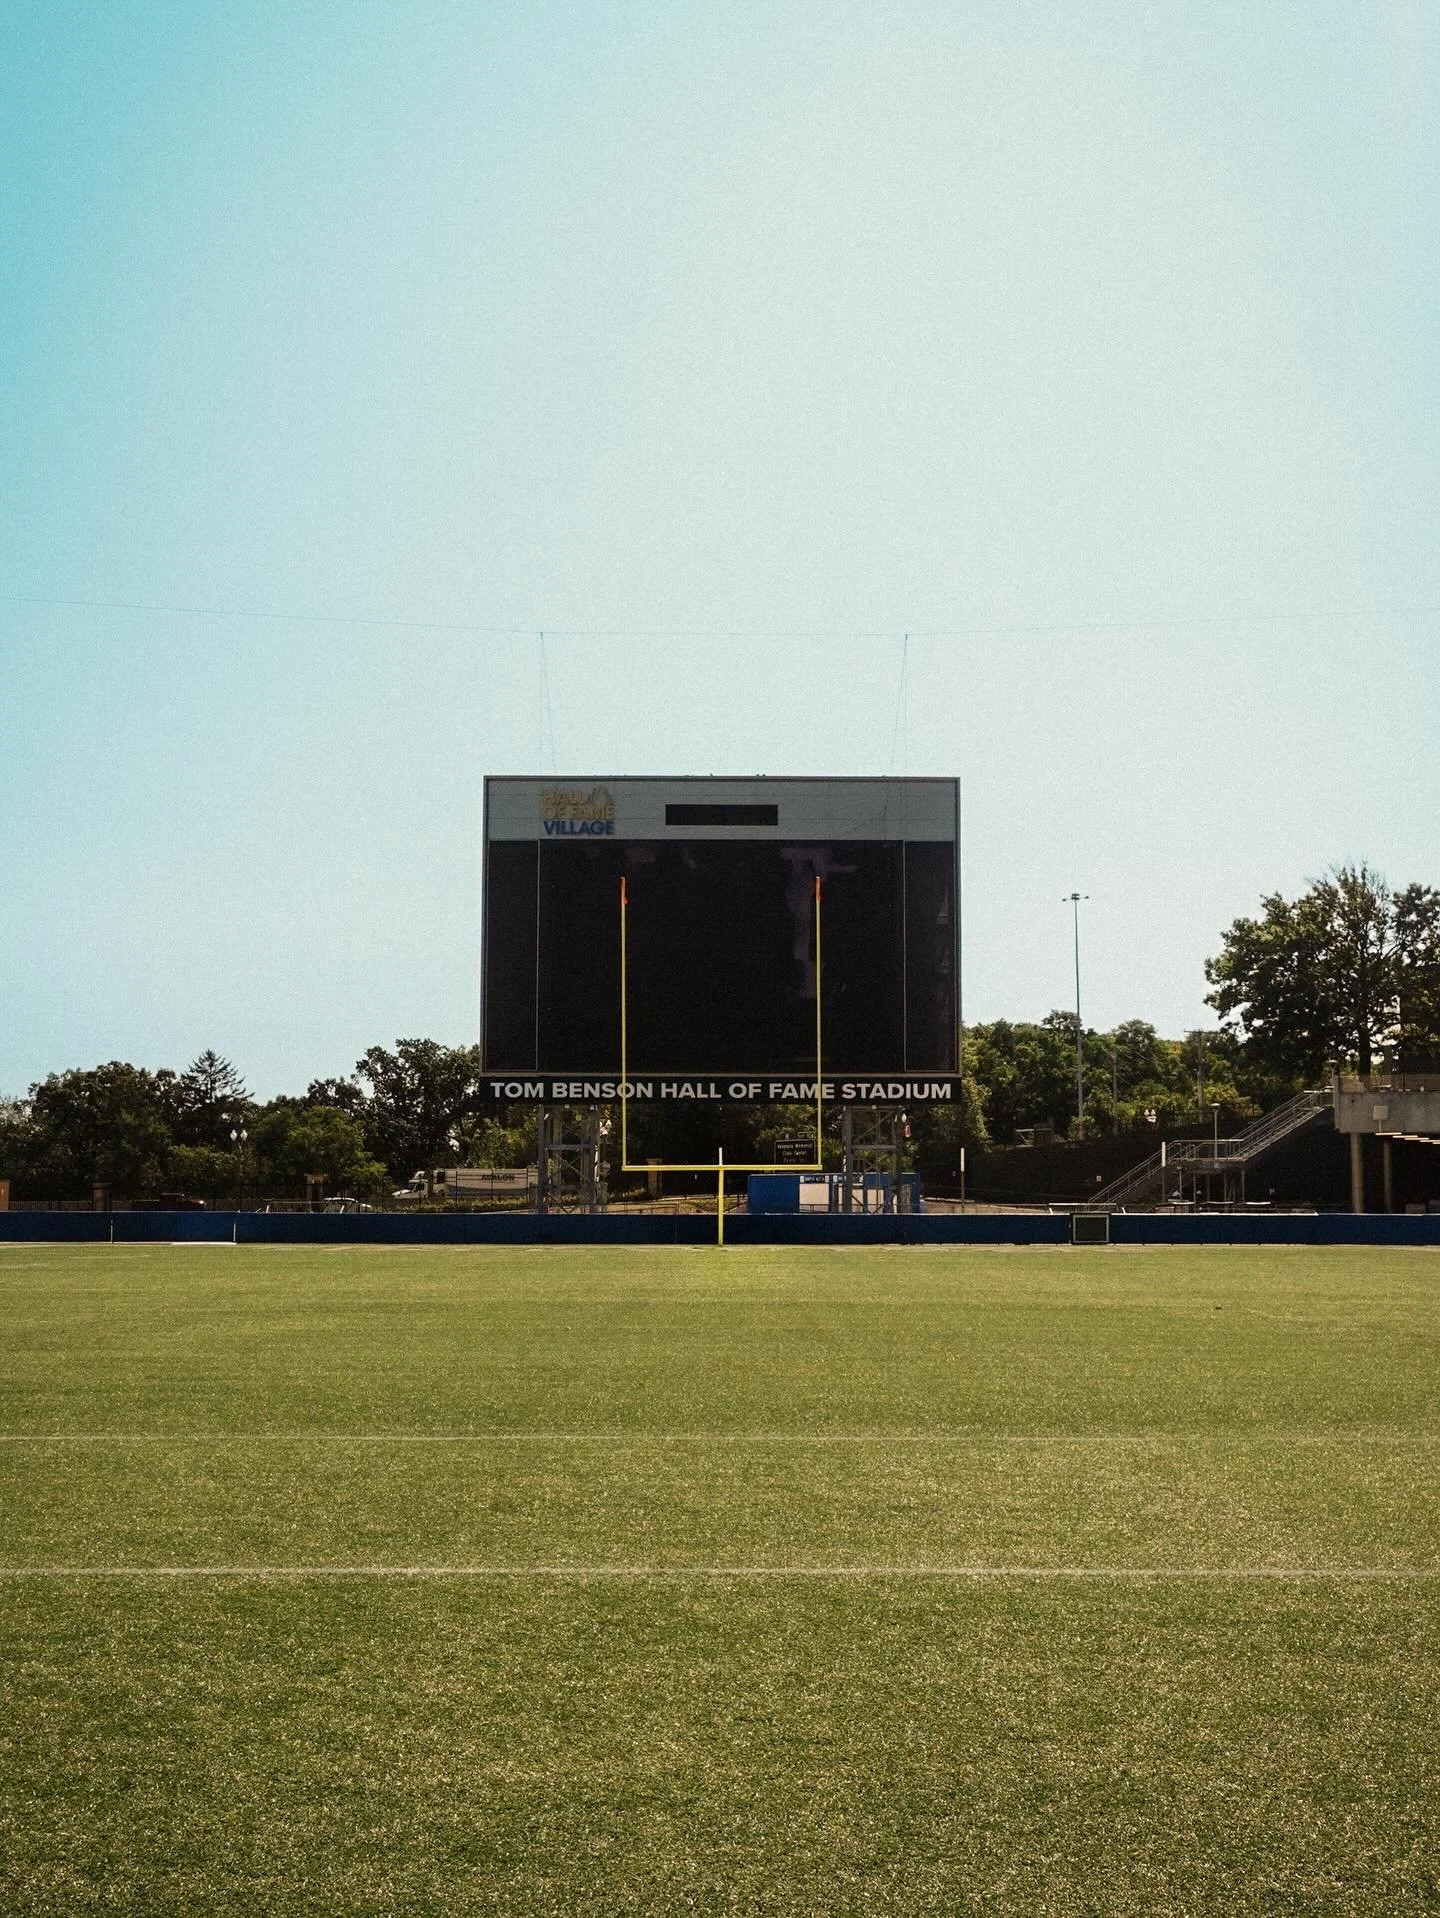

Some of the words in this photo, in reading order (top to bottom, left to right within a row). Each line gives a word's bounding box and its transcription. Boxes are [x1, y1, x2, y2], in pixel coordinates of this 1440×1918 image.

[543, 790, 585, 805] HALL
[543, 820, 615, 835] VILLAGE
[490, 1082, 545, 1098] TOM
[552, 1082, 653, 1098] BENSON
[661, 1083, 722, 1098] HALL
[729, 1083, 762, 1099] OF
[769, 1083, 835, 1098] FAME
[841, 1083, 951, 1099] STADIUM
